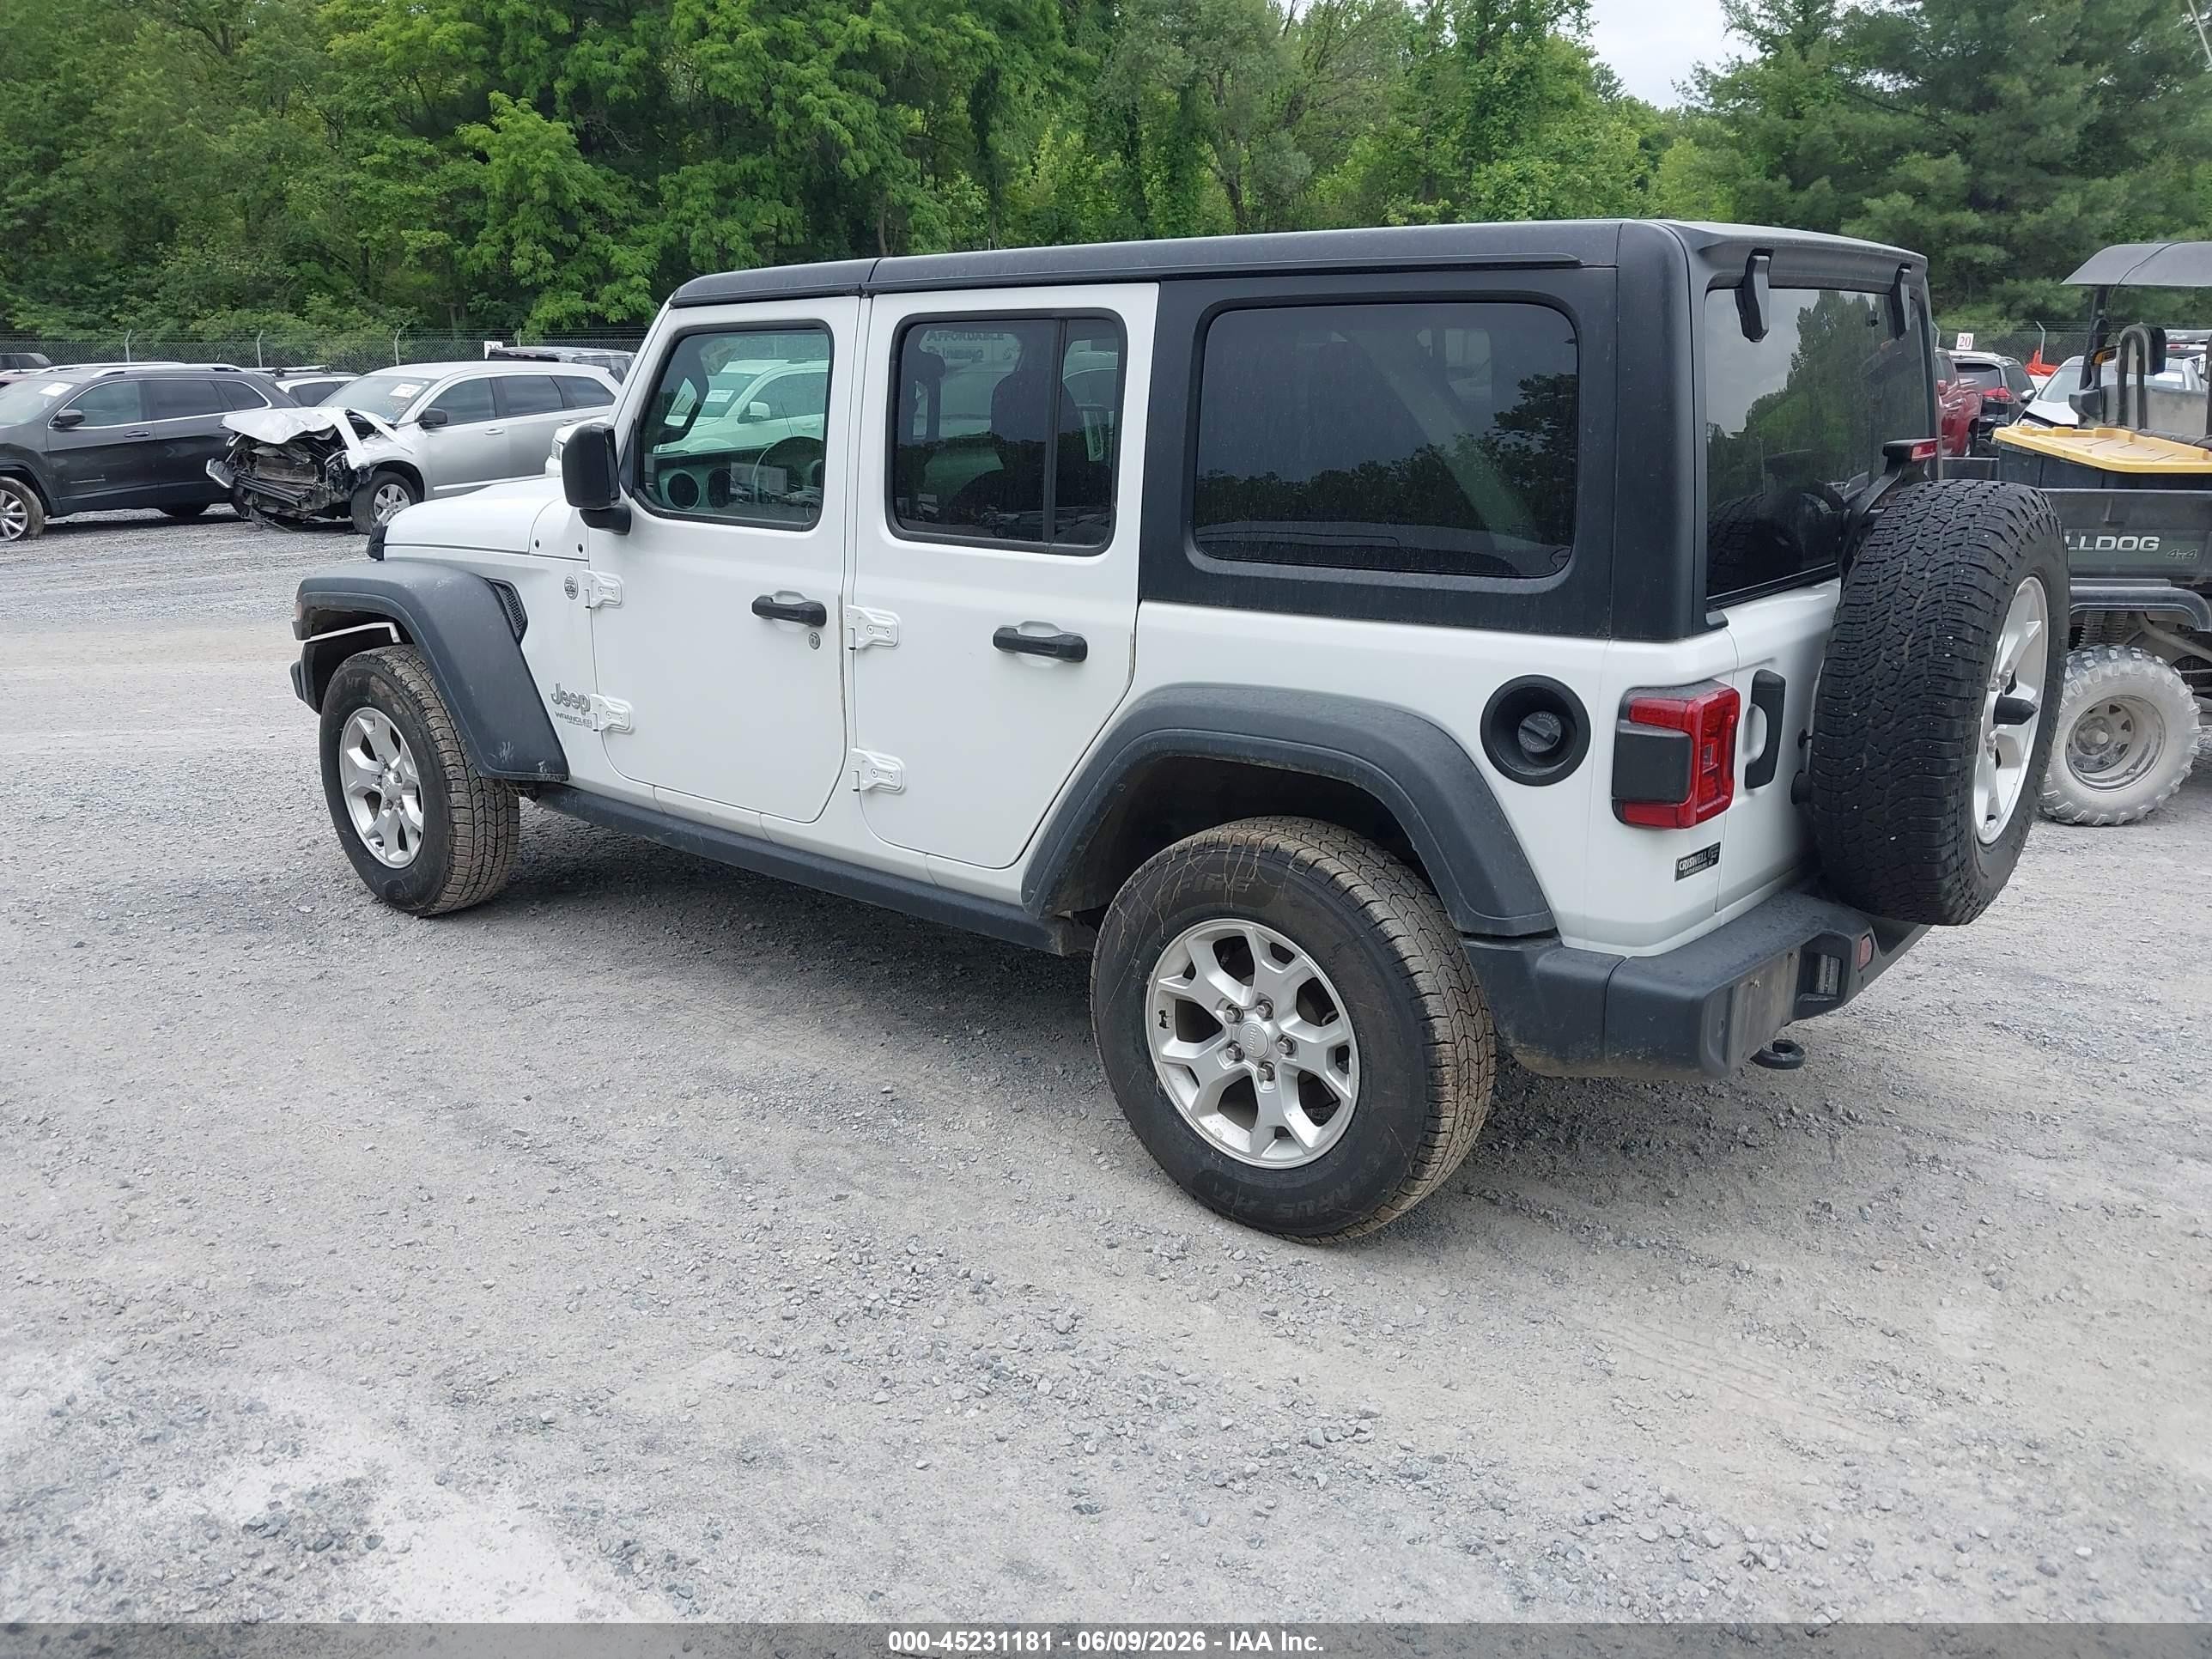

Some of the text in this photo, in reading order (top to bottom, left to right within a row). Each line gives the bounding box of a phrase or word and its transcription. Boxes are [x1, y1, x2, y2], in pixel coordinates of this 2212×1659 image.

[1959, 337, 1972, 348] 20
[550, 682, 591, 716] Jeep
[555, 711, 592, 726] WRANGLER
